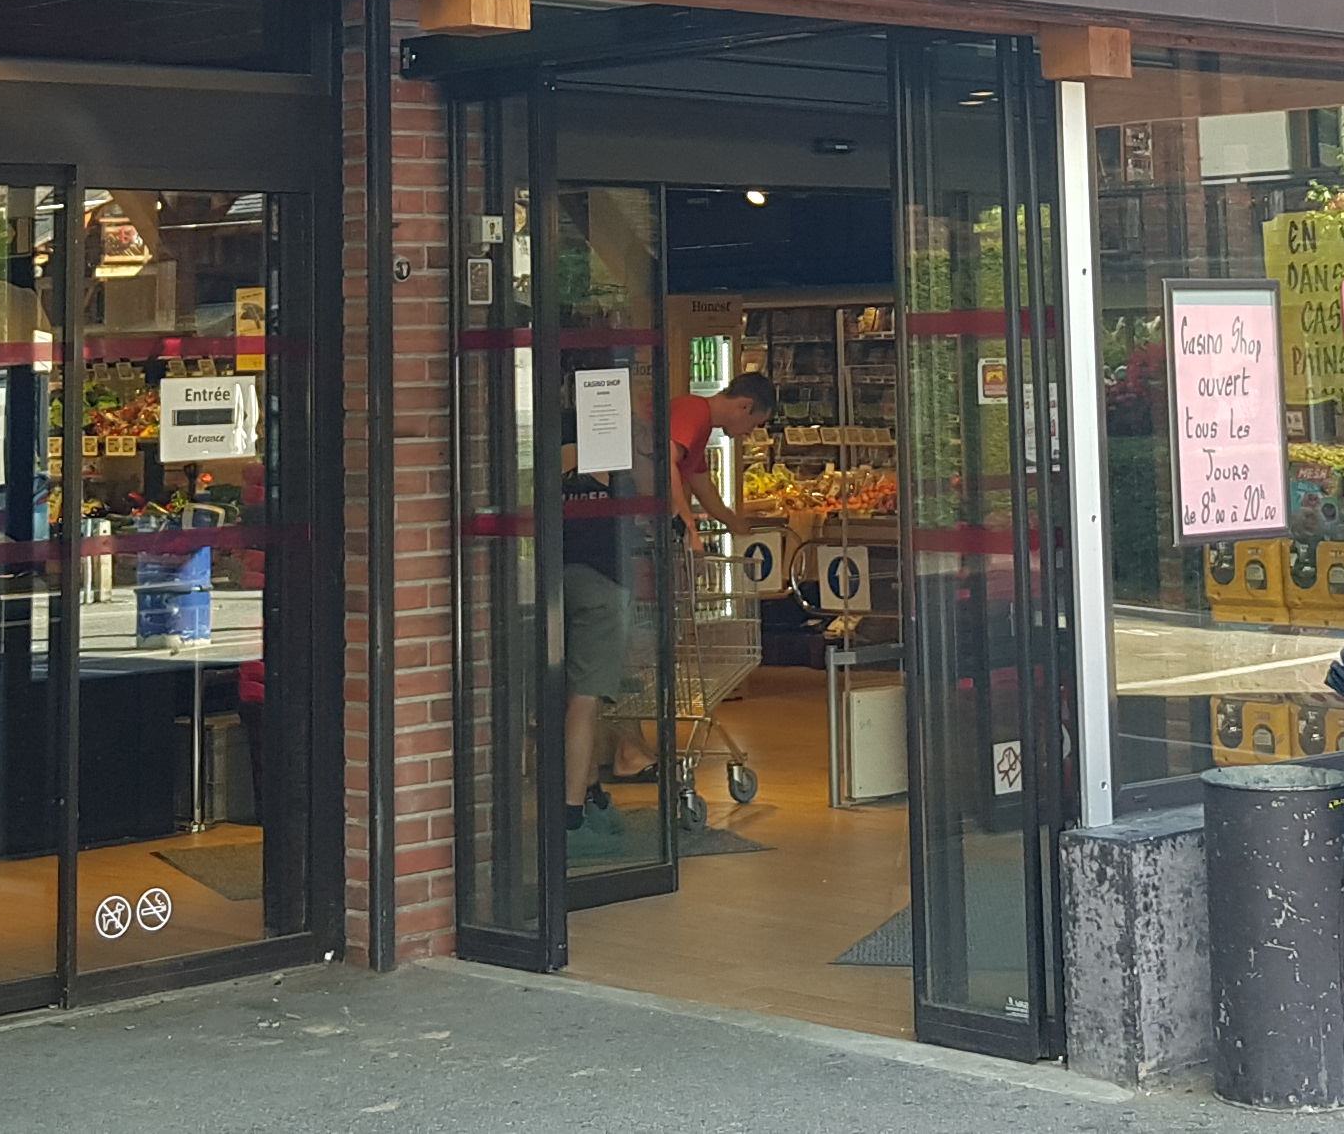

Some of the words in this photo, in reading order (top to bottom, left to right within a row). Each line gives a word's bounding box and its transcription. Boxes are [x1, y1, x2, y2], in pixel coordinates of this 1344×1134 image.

[1288, 219, 1317, 254] EN
[1181, 316, 1222, 355] Casino
[1231, 316, 1261, 363] Shop
[185, 387, 230, 402] Entrée
[1198, 367, 1250, 396] ouvert
[1185, 407, 1217, 439] tous
[187, 434, 226, 443] Entrance
[1184, 505, 1196, 526] de
